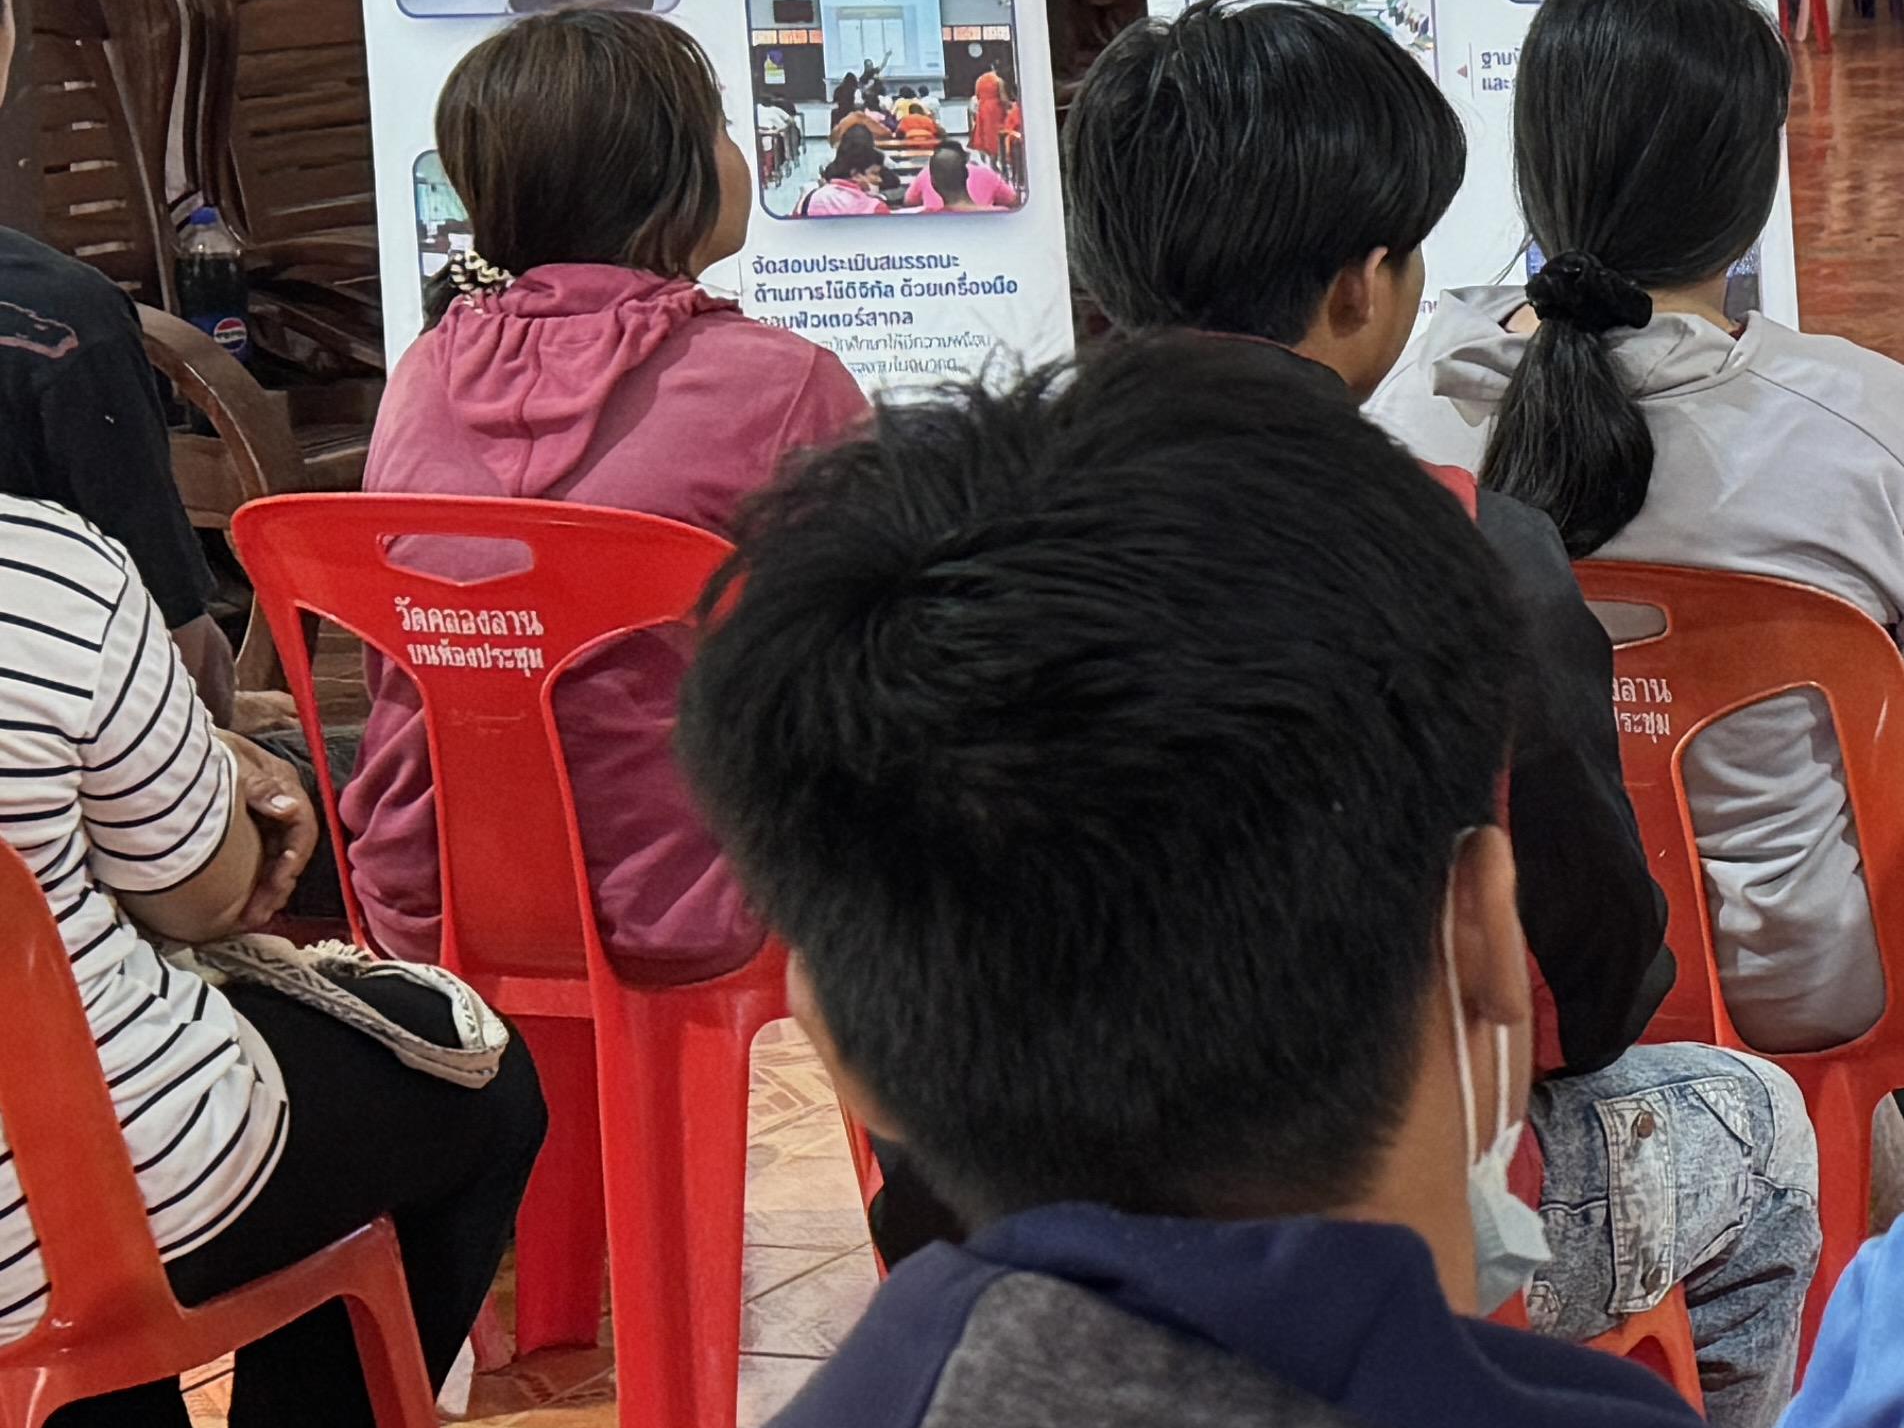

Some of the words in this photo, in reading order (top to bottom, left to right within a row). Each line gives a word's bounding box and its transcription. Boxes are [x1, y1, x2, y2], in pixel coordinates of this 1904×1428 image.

[395, 596, 545, 638] วัดคลองลาน
[408, 638, 544, 677] บนห้องประชุม
